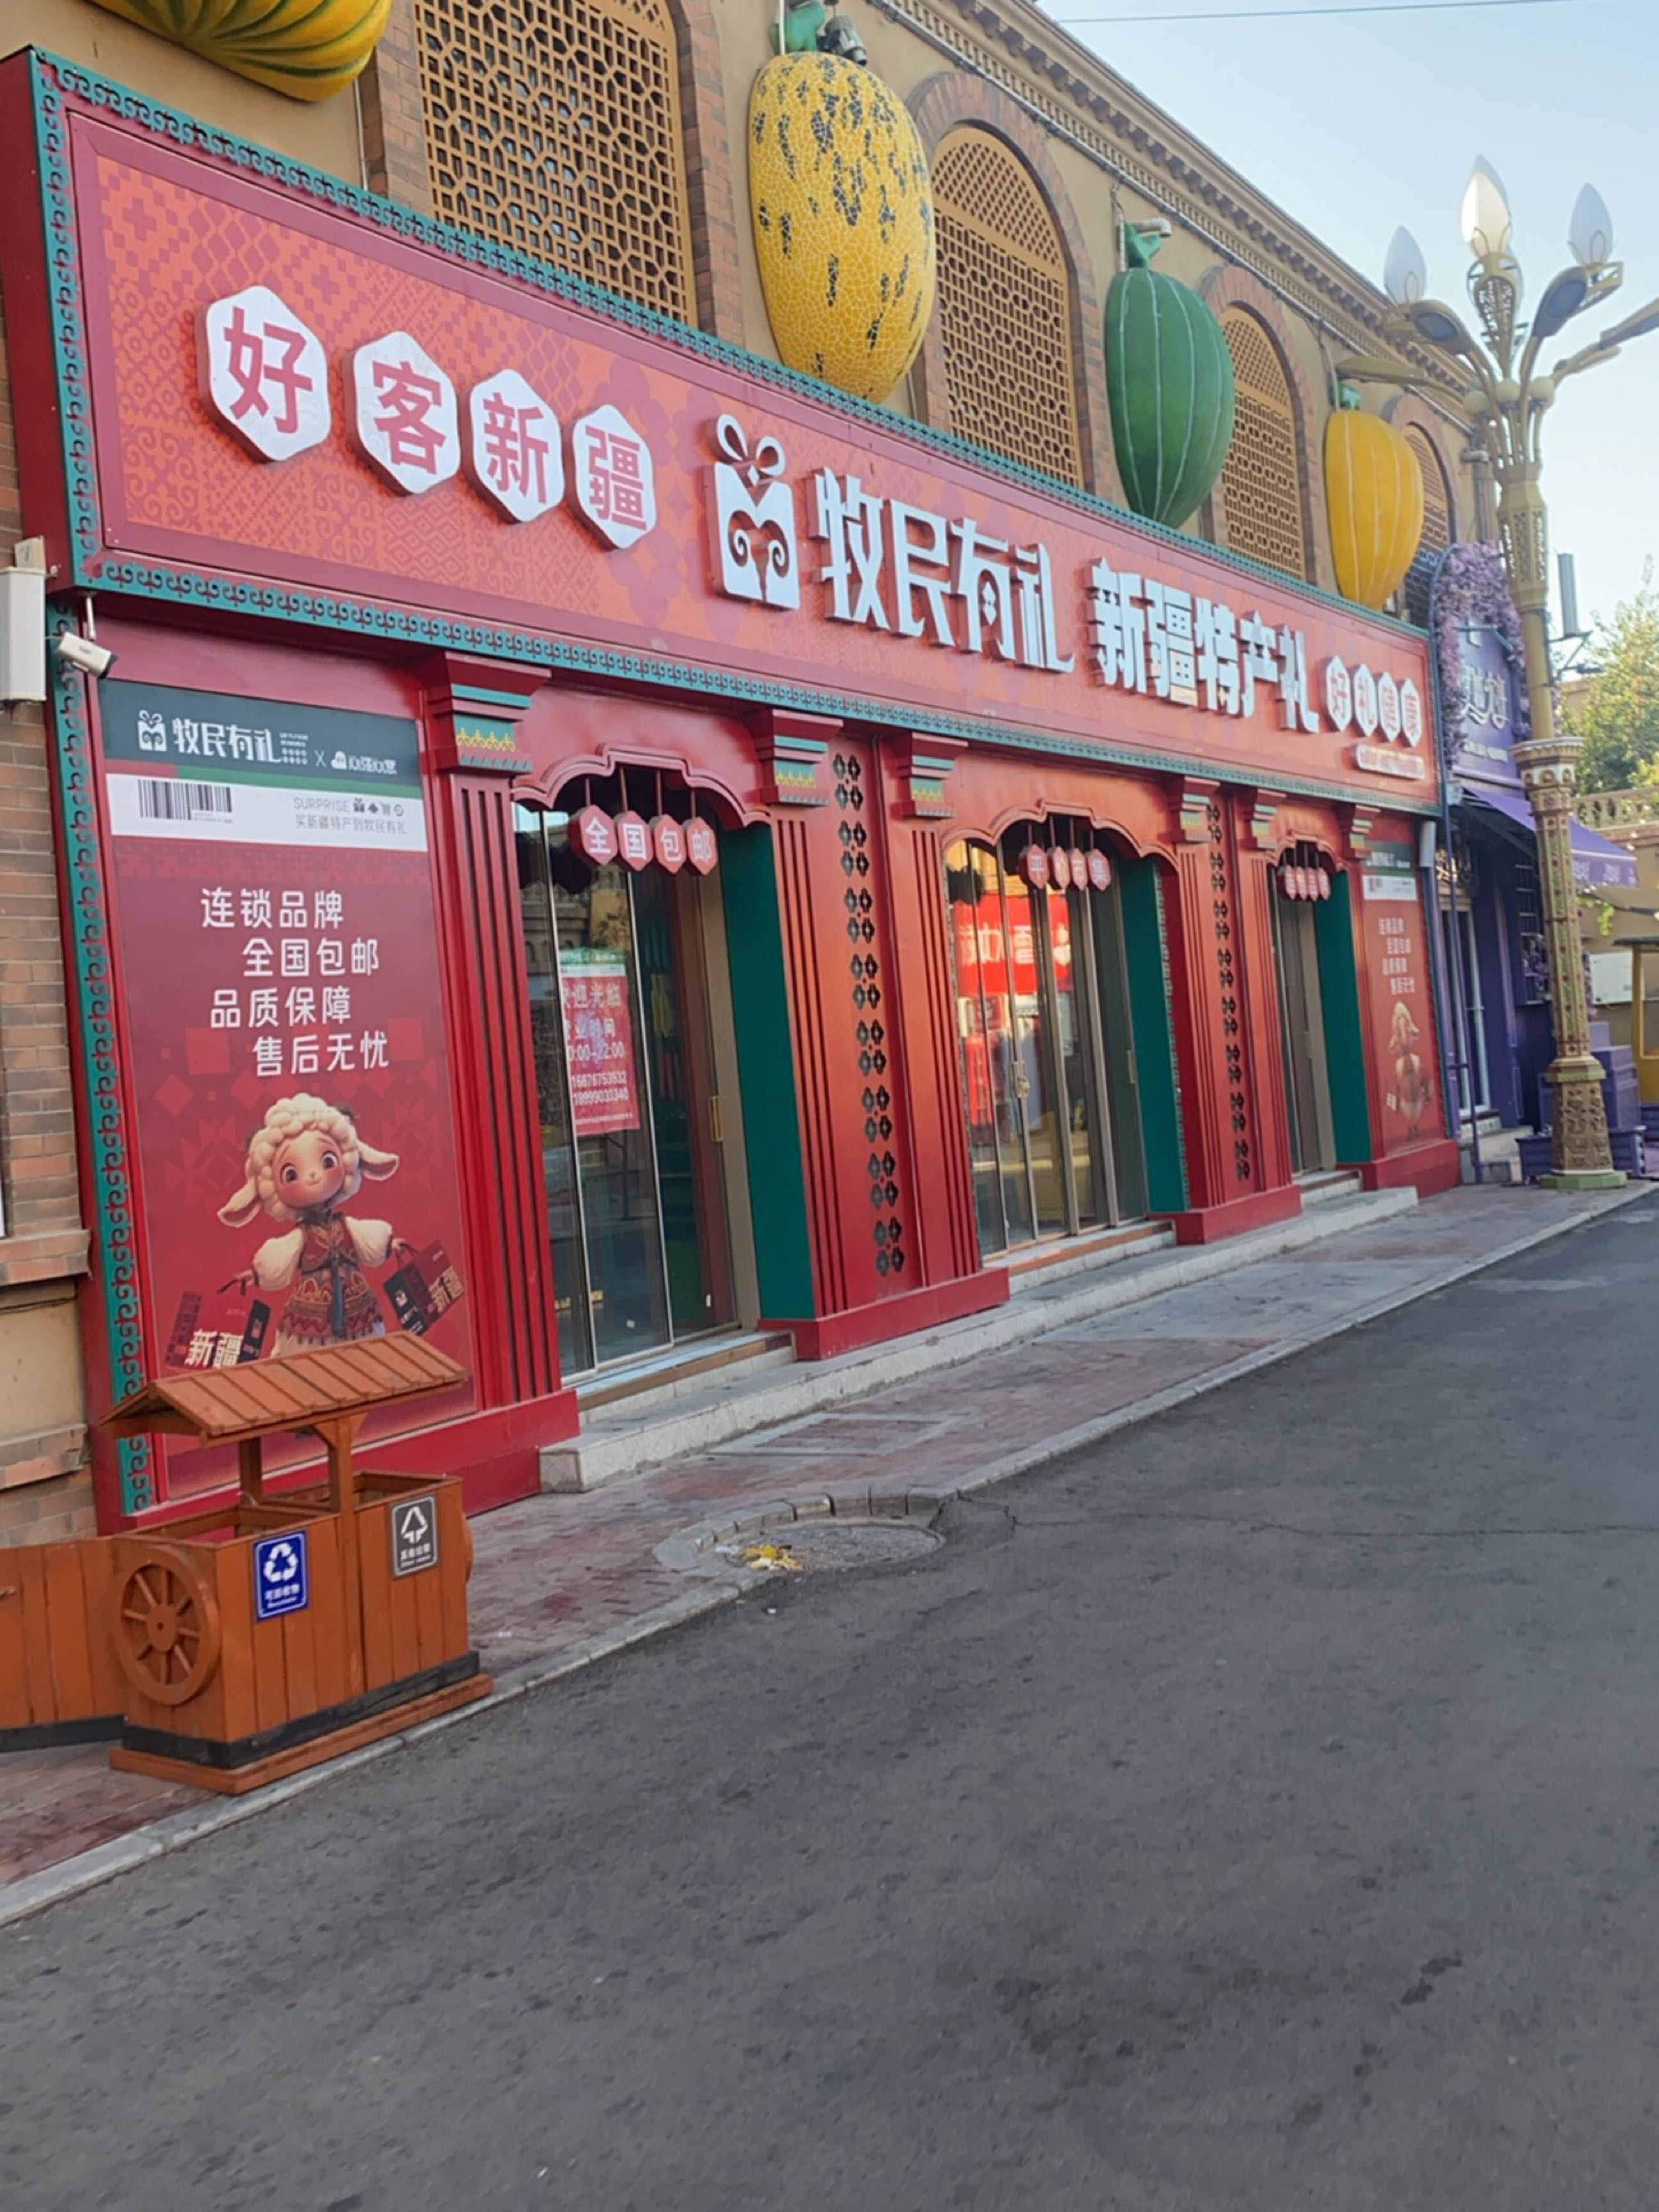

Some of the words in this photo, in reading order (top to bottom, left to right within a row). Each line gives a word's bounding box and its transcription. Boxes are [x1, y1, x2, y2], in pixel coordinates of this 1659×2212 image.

[224, 306, 648, 531] 好客新疆
[813, 467, 1075, 673] 牧民有礼
[1091, 557, 1320, 733] 新疆特产礼
[172, 717, 282, 763] 牧民有礼
[293, 796, 351, 812] SURPRISE
[585, 816, 712, 863] 全国包邮
[200, 886, 344, 929] 连锁品牌
[242, 936, 379, 977] 全国包邮
[211, 984, 351, 1029] 品质保障
[252, 1029, 389, 1077] 售后无忧
[184, 1328, 244, 1368] 新疆
